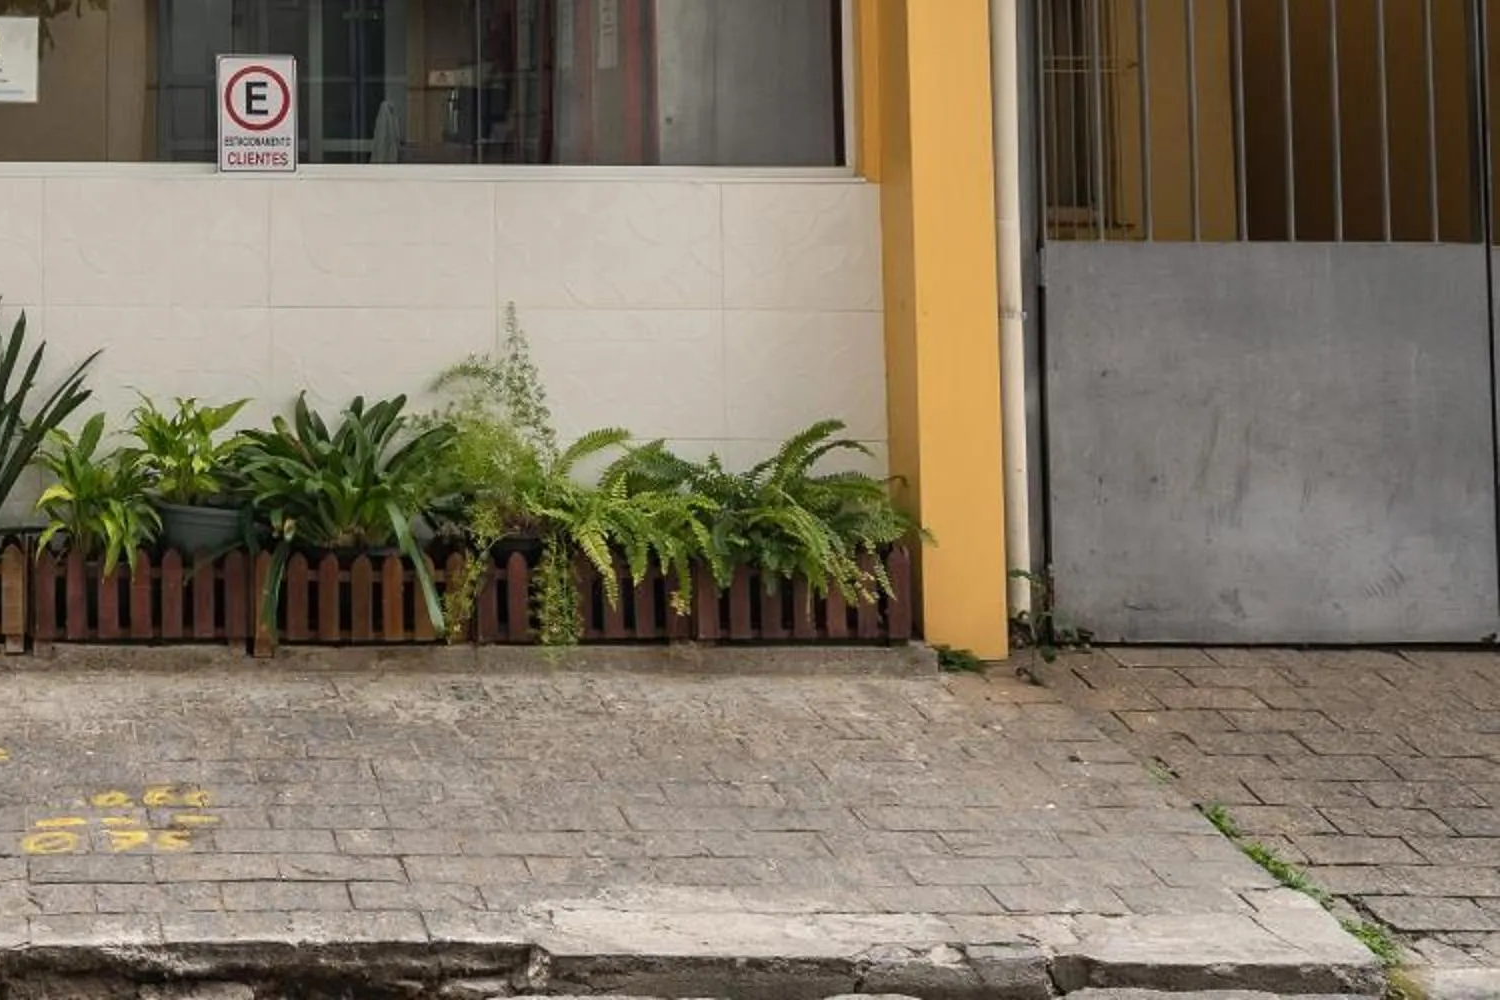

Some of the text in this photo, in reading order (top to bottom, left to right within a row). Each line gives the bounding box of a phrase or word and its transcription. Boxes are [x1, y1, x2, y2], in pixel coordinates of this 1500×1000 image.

[245, 81, 269, 115] E
[224, 136, 291, 147] ESTACIONAMENTO
[227, 151, 289, 166] CLIENTES
